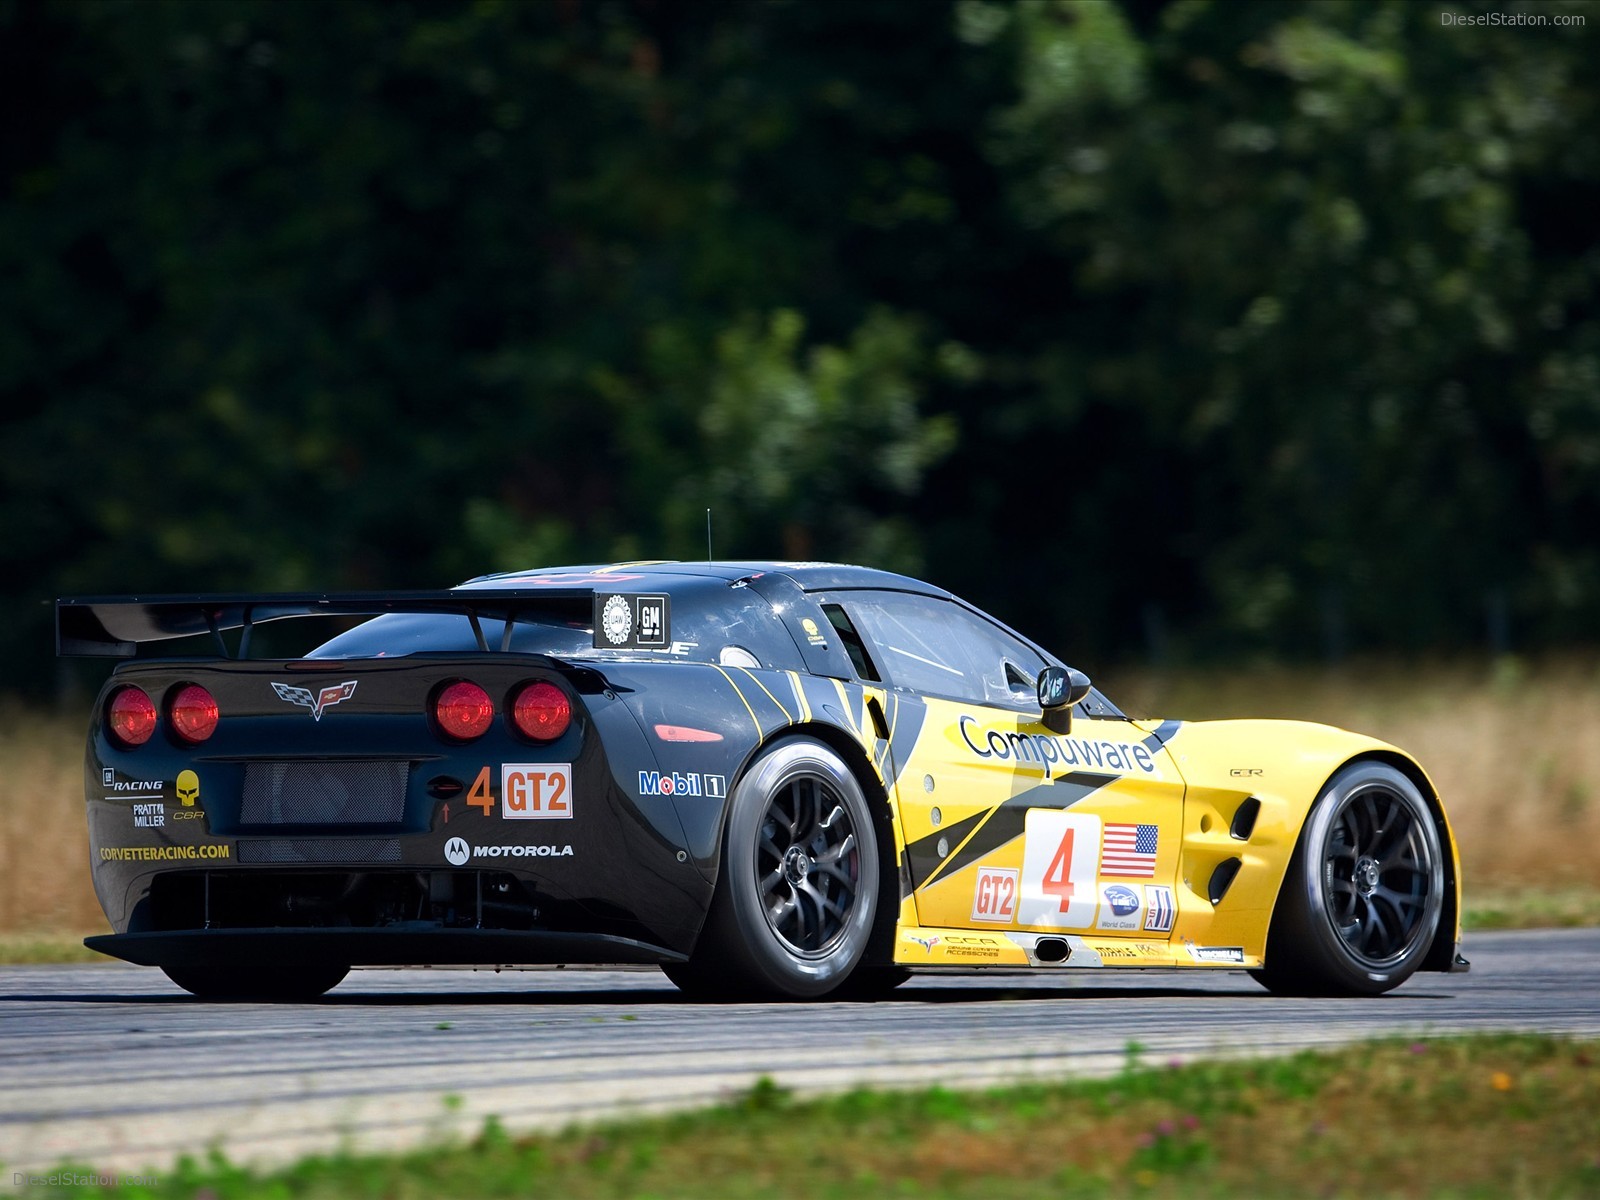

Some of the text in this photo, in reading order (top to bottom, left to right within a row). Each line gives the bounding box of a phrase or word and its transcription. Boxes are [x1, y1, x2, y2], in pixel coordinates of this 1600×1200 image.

[642, 606, 660, 628] GM
[959, 714, 1155, 779] Compuware
[114, 780, 164, 791] RACING
[466, 766, 495, 817] 4
[506, 771, 568, 812] GT2
[638, 770, 702, 797] Mobil
[133, 803, 157, 815] PRATT
[173, 811, 205, 820] C6R
[134, 815, 165, 827] MILLER
[100, 844, 230, 860] CORVETTERACING.COM
[473, 845, 574, 857] MOTOROLA
[1042, 827, 1075, 913] 4
[976, 874, 1015, 915] GT2
[1101, 921, 1136, 929] World Class
